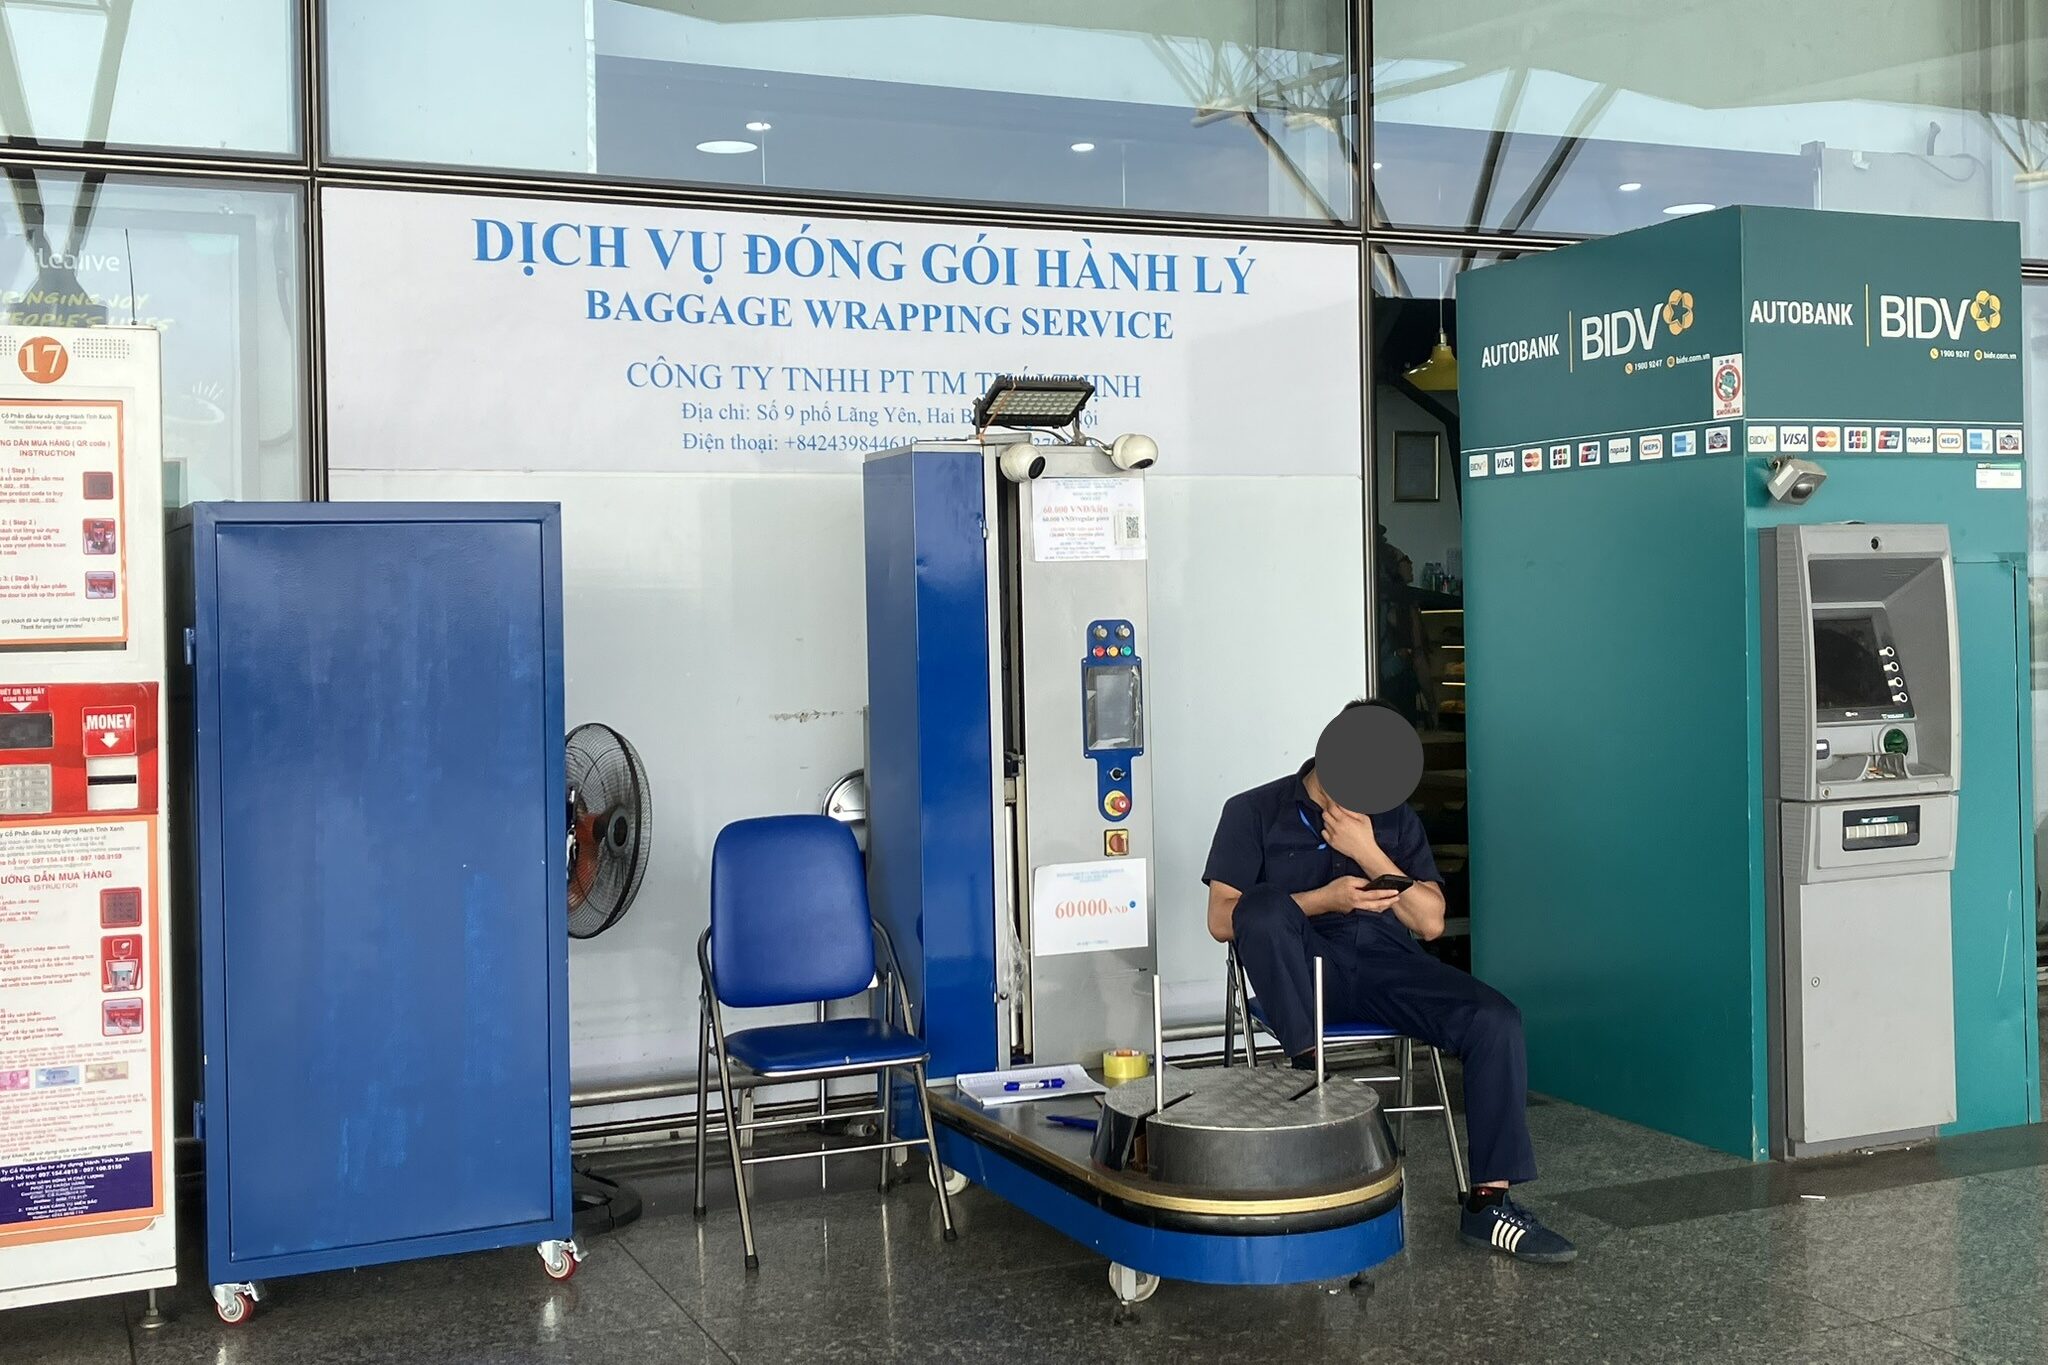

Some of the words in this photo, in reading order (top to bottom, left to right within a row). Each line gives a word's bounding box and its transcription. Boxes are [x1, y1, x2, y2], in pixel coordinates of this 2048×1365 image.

[472, 218, 630, 276] DỊCH
[645, 228, 727, 284] VỤ
[743, 224, 906, 282] ĐÓNG
[922, 233, 1020, 286] GÓI
[1035, 238, 1179, 292] HÀNH
[1193, 246, 1256, 294] LÝ
[585, 289, 792, 327] BAGGAGE
[804, 299, 1011, 335] WRAPPING
[1022, 307, 1174, 339] SERVICE
[1749, 300, 1854, 326] AUTOBANK
[1880, 295, 1972, 340] BIDV
[1481, 333, 1560, 368] AUTOBANK
[1581, 303, 1664, 360] BIDV
[21, 343, 62, 374] 17
[1676, 353, 1710, 365] bidv.com.vn
[1983, 351, 2017, 360] bidv.com.vn
[626, 355, 722, 389] CÔNG
[731, 365, 774, 391] TY
[782, 366, 869, 393] TNHH
[878, 369, 914, 395] PT
[921, 370, 967, 396] TM
[681, 402, 713, 423] Địa
[757, 399, 779, 421] Số
[784, 404, 795, 420] 9
[800, 400, 831, 426] phố
[837, 405, 879, 427] Lãng
[884, 406, 921, 425] Yên,
[927, 407, 955, 424] Hai
[682, 432, 724, 453] Điện
[730, 433, 778, 454] thoại:
[1749, 435, 1768, 445] BIDV
[1783, 433, 1807, 445] VISA
[19, 449, 76, 457] INSTRUCTION
[1497, 457, 1513, 469] VISA
[86, 713, 132, 731] MONEY
[59, 872, 80, 881] MUA
[83, 869, 112, 880] HÀNG
[28, 882, 78, 892] INSTRUCTION
